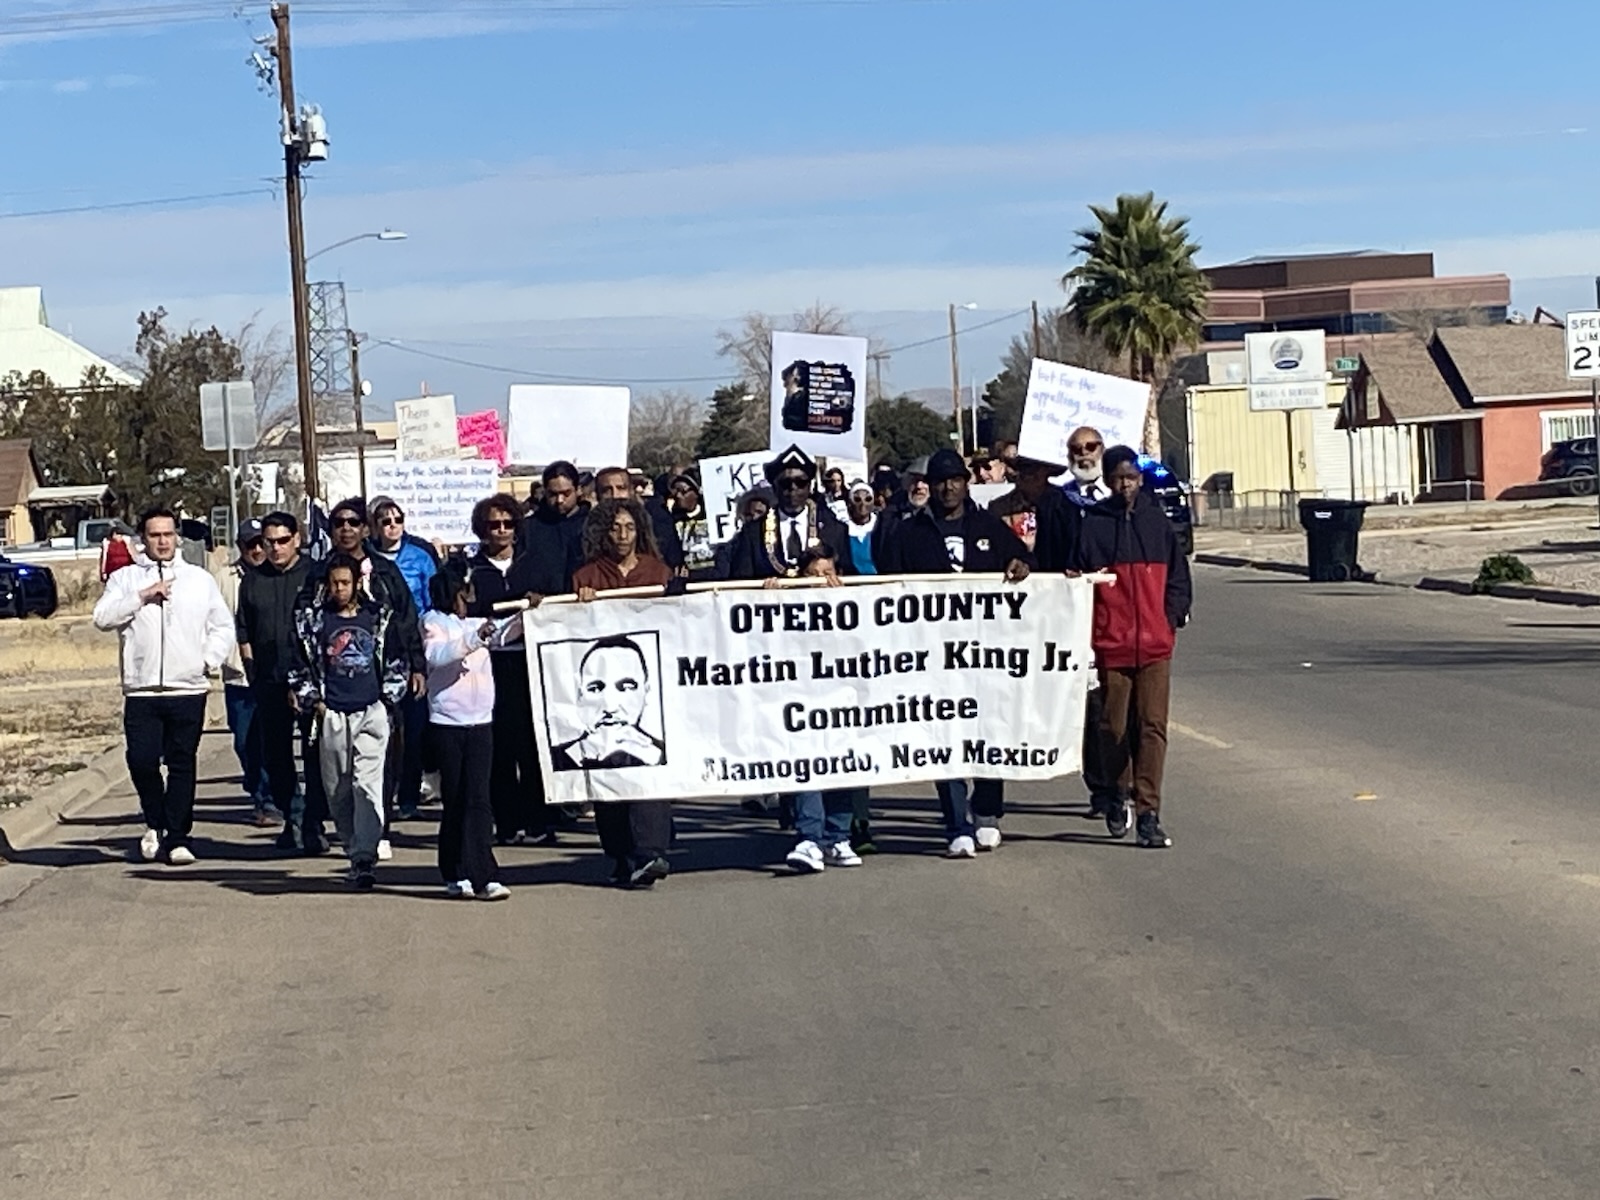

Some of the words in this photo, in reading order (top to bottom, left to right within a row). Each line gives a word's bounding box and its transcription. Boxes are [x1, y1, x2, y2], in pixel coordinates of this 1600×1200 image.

[1571, 318, 1600, 330] SPE
[1573, 346, 1600, 370] 2
[730, 600, 859, 634] OTERO
[873, 592, 1028, 627] COUNTY
[676, 654, 798, 687] Martin
[811, 648, 930, 680] Luther
[944, 640, 1030, 679] King
[1042, 641, 1079, 673] Jr.
[783, 694, 979, 733] Committee
[890, 743, 953, 769] New
[962, 739, 1060, 767] Mexico
